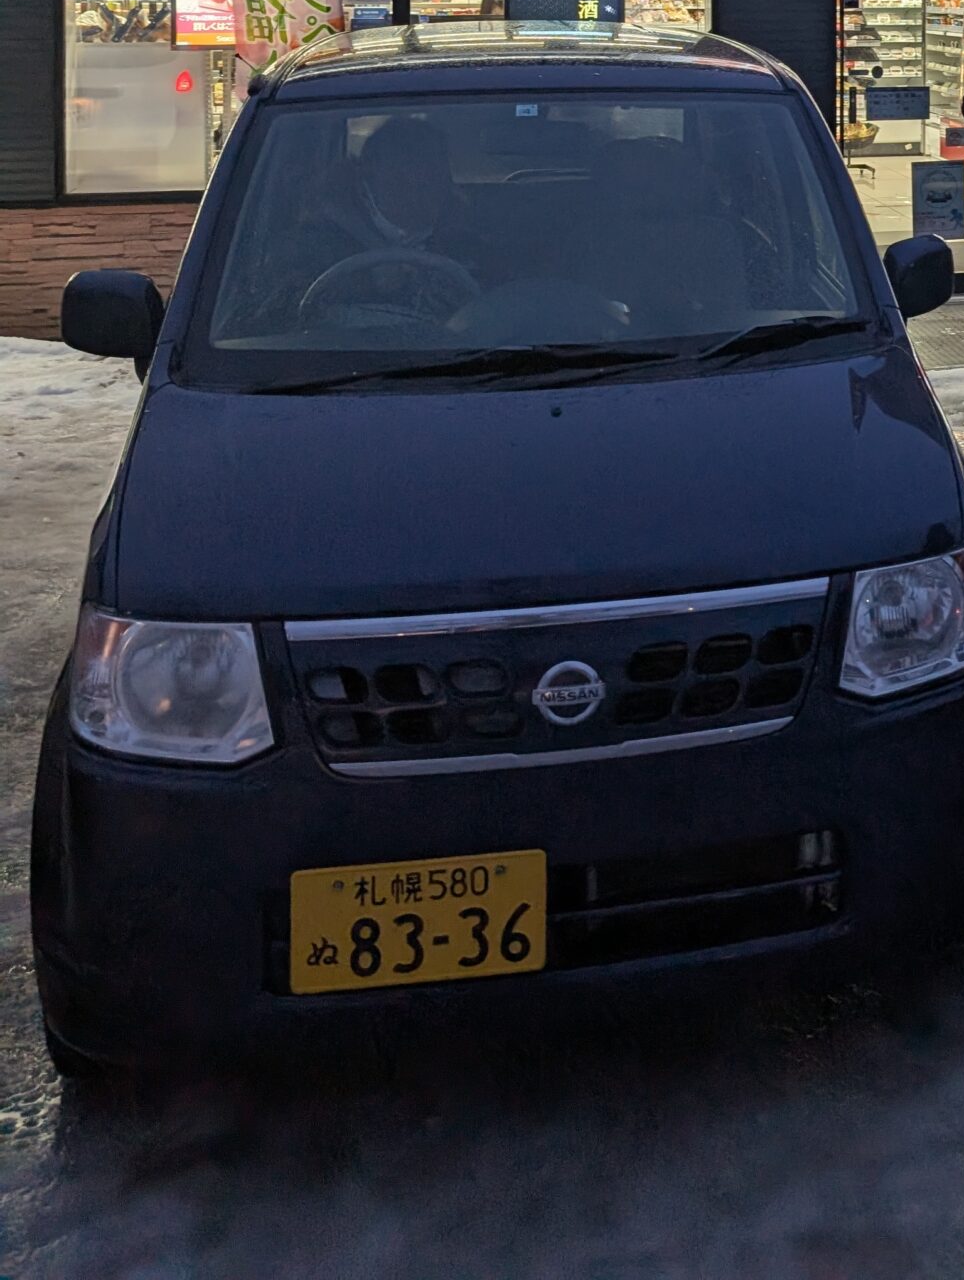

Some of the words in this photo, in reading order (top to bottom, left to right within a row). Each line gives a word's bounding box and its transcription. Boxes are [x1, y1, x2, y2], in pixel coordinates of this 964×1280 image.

[541, 688, 599, 702] NISSAN
[306, 937, 339, 966] ぬ
[350, 902, 531, 977] 83-36
